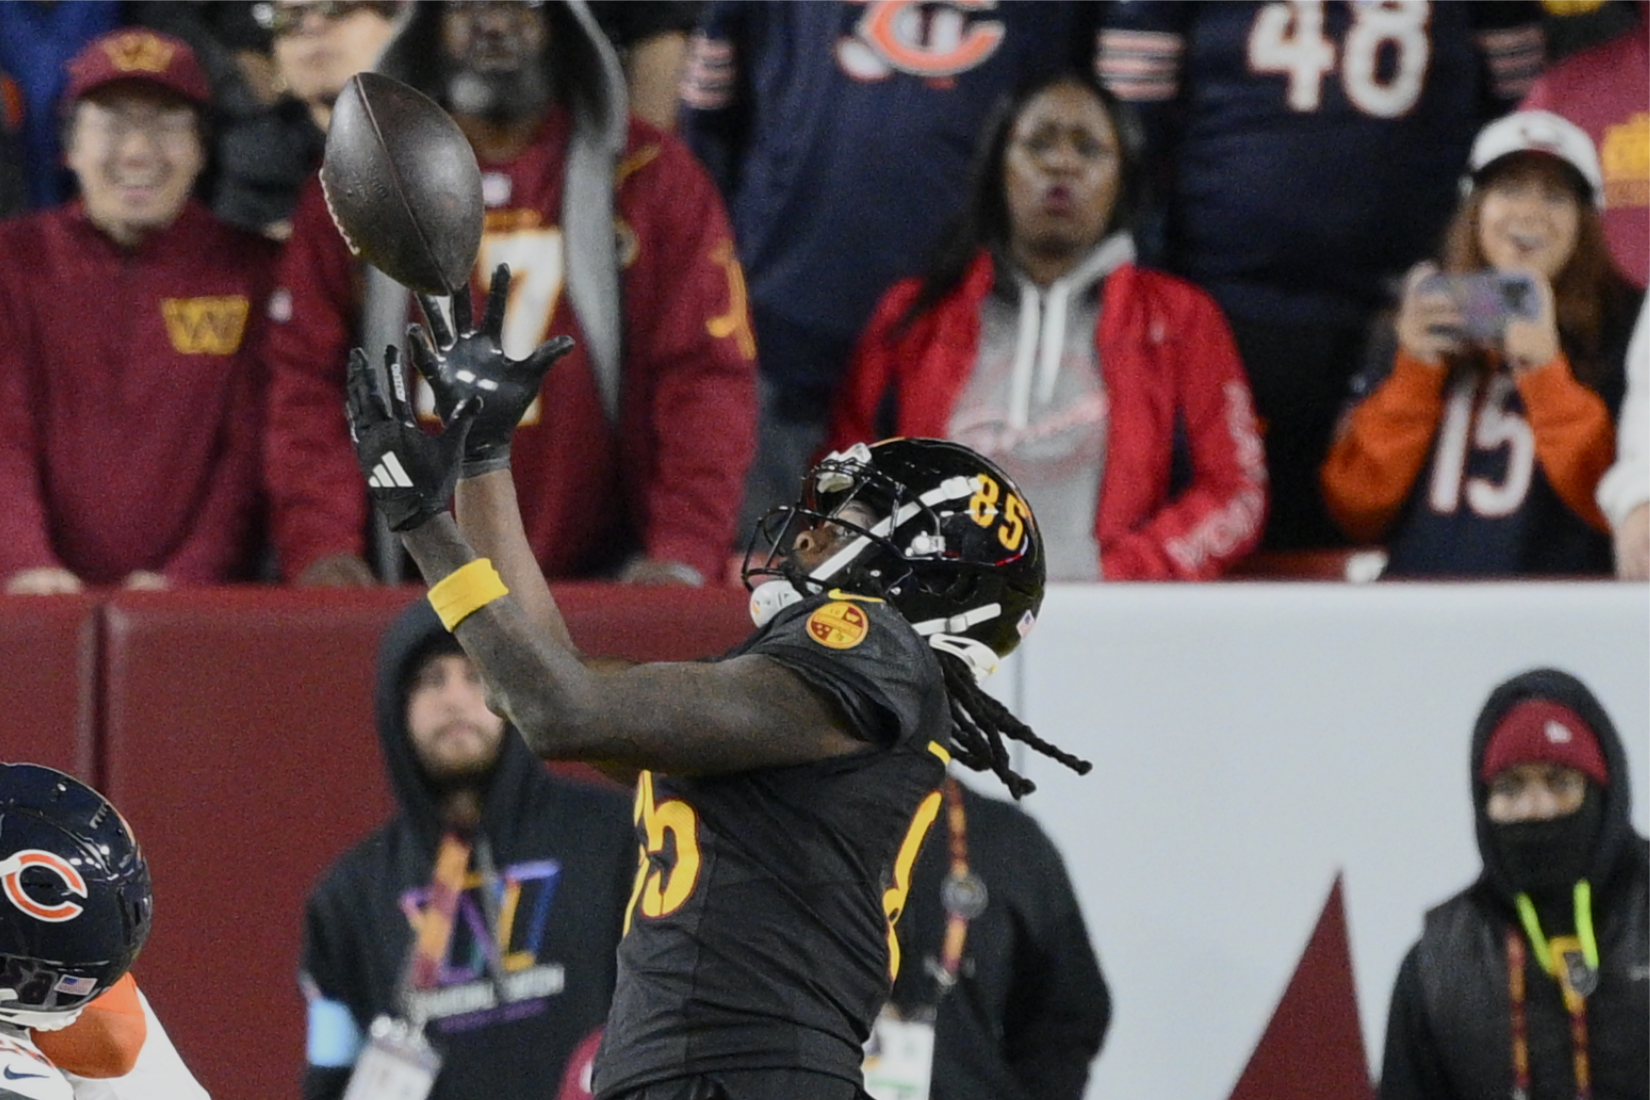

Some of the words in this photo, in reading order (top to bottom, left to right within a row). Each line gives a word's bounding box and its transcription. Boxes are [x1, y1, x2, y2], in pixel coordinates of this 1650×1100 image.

[1249, 0, 1430, 119] 48
[1430, 372, 1535, 519] 15
[969, 473, 1028, 551] 85
